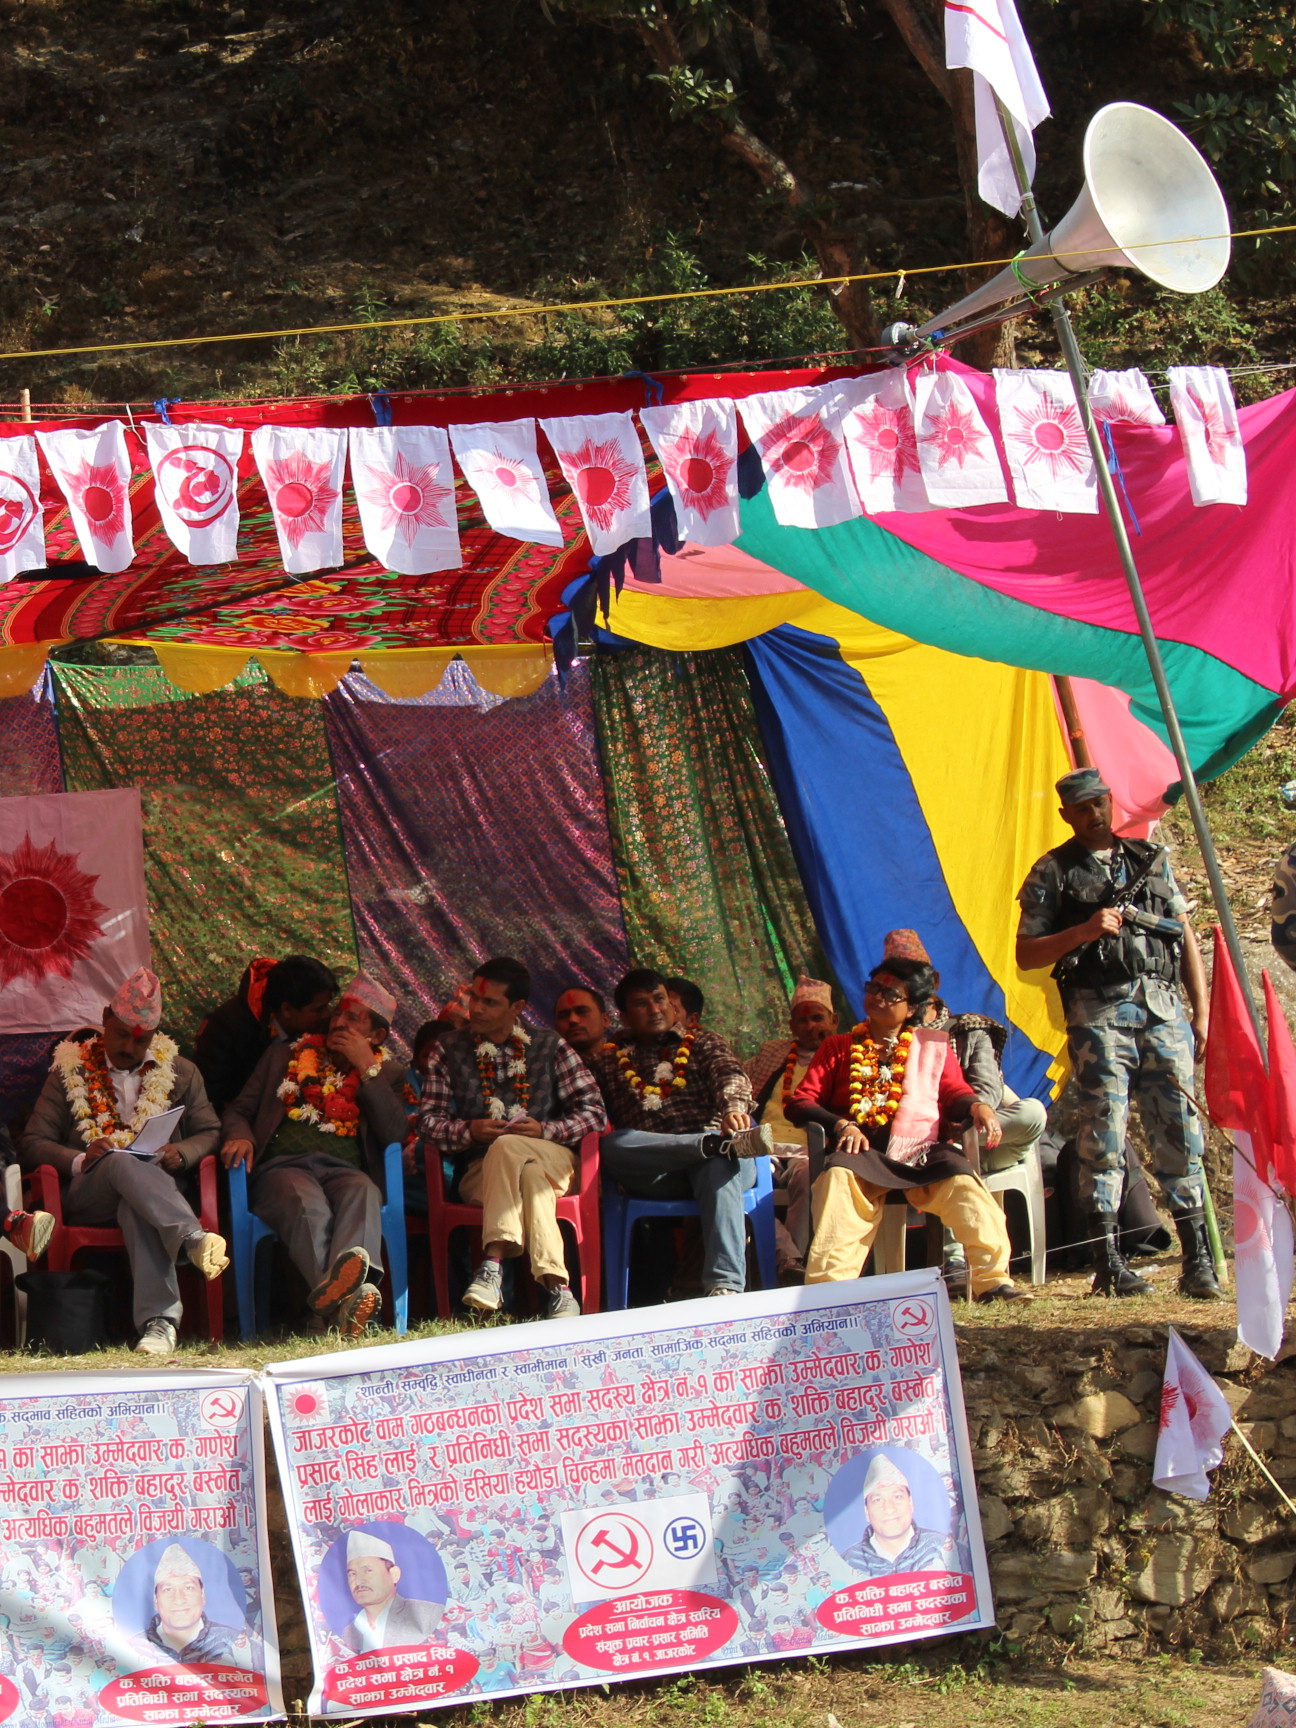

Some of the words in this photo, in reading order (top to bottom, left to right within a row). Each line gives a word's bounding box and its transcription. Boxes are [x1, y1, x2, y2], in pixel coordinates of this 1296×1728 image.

[444, 1367, 497, 1387] स्वाधीनता
[501, 1367, 509, 1379] र
[513, 1358, 568, 1376] स्वाभीमान
[581, 1351, 608, 1369] सुखी
[651, 1339, 704, 1357] सामाजिक
[751, 1322, 797, 1343] सहितको
[291, 1416, 371, 1453] जाजरकोट
[375, 1417, 405, 1442] वाम
[410, 1402, 503, 1437] गठबन्धनका
[506, 1392, 545, 1426] प्रदेश
[548, 1391, 582, 1419] सभा
[586, 1384, 637, 1413] सदस्य
[640, 1374, 671, 1405] क्षेत्र
[697, 1374, 709, 1395] १
[712, 1369, 735, 1393] का
[739, 1363, 785, 1393] साझा
[864, 1349, 886, 1372] क.
[888, 1337, 932, 1368] गणेश
[295, 1459, 341, 1489] प्रसाद
[344, 1449, 377, 1480] सिंह
[383, 1443, 418, 1476] लाई
[428, 1448, 442, 1469] र
[444, 1429, 512, 1470] प्रतिनिधी
[516, 1428, 551, 1458] सभा
[555, 1419, 630, 1451] सदस्यका
[633, 1411, 681, 1441] साझा
[763, 1398, 787, 1420] क.
[791, 1385, 830, 1419] शक्ति
[835, 1382, 886, 1412] बहादुर
[891, 1371, 936, 1403] बस्नेत
[302, 1496, 333, 1524] लाई
[337, 1486, 406, 1518] गोलाकार
[408, 1475, 462, 1510] भित्रको
[463, 1468, 511, 1503] हसिया
[562, 1456, 618, 1486] चिन्हमा
[621, 1449, 674, 1478] मतदान
[677, 1438, 706, 1469] गरी
[709, 1430, 776, 1466] अत्यधिक
[779, 1419, 838, 1460] बहुमतले
[839, 1412, 889, 1447] विजयी
[613, 1593, 673, 1613] आयोजक
[856, 1585, 885, 1603] शक्ति
[888, 1581, 927, 1597] बहादुर
[929, 1575, 963, 1591] बस्नेत
[833, 1603, 884, 1624] प्रतिनिधी
[886, 1600, 912, 1616] सभा
[915, 1592, 968, 1611] सदस्यका
[579, 1623, 602, 1639] प्रदेश
[605, 1621, 626, 1634] सभा
[627, 1615, 665, 1631] निर्वाचन
[667, 1611, 687, 1626] क्षेत्र
[679, 1624, 709, 1641] समिति
[860, 1620, 895, 1636] साझा
[355, 1655, 390, 1671] गणेश
[393, 1651, 427, 1667] प्रसाद
[430, 1646, 456, 1661] सिंह
[336, 1676, 366, 1692] प्रदेश
[370, 1672, 397, 1686] सभा
[399, 1666, 424, 1682] क्षेत्र
[349, 1690, 384, 1705] साझा
